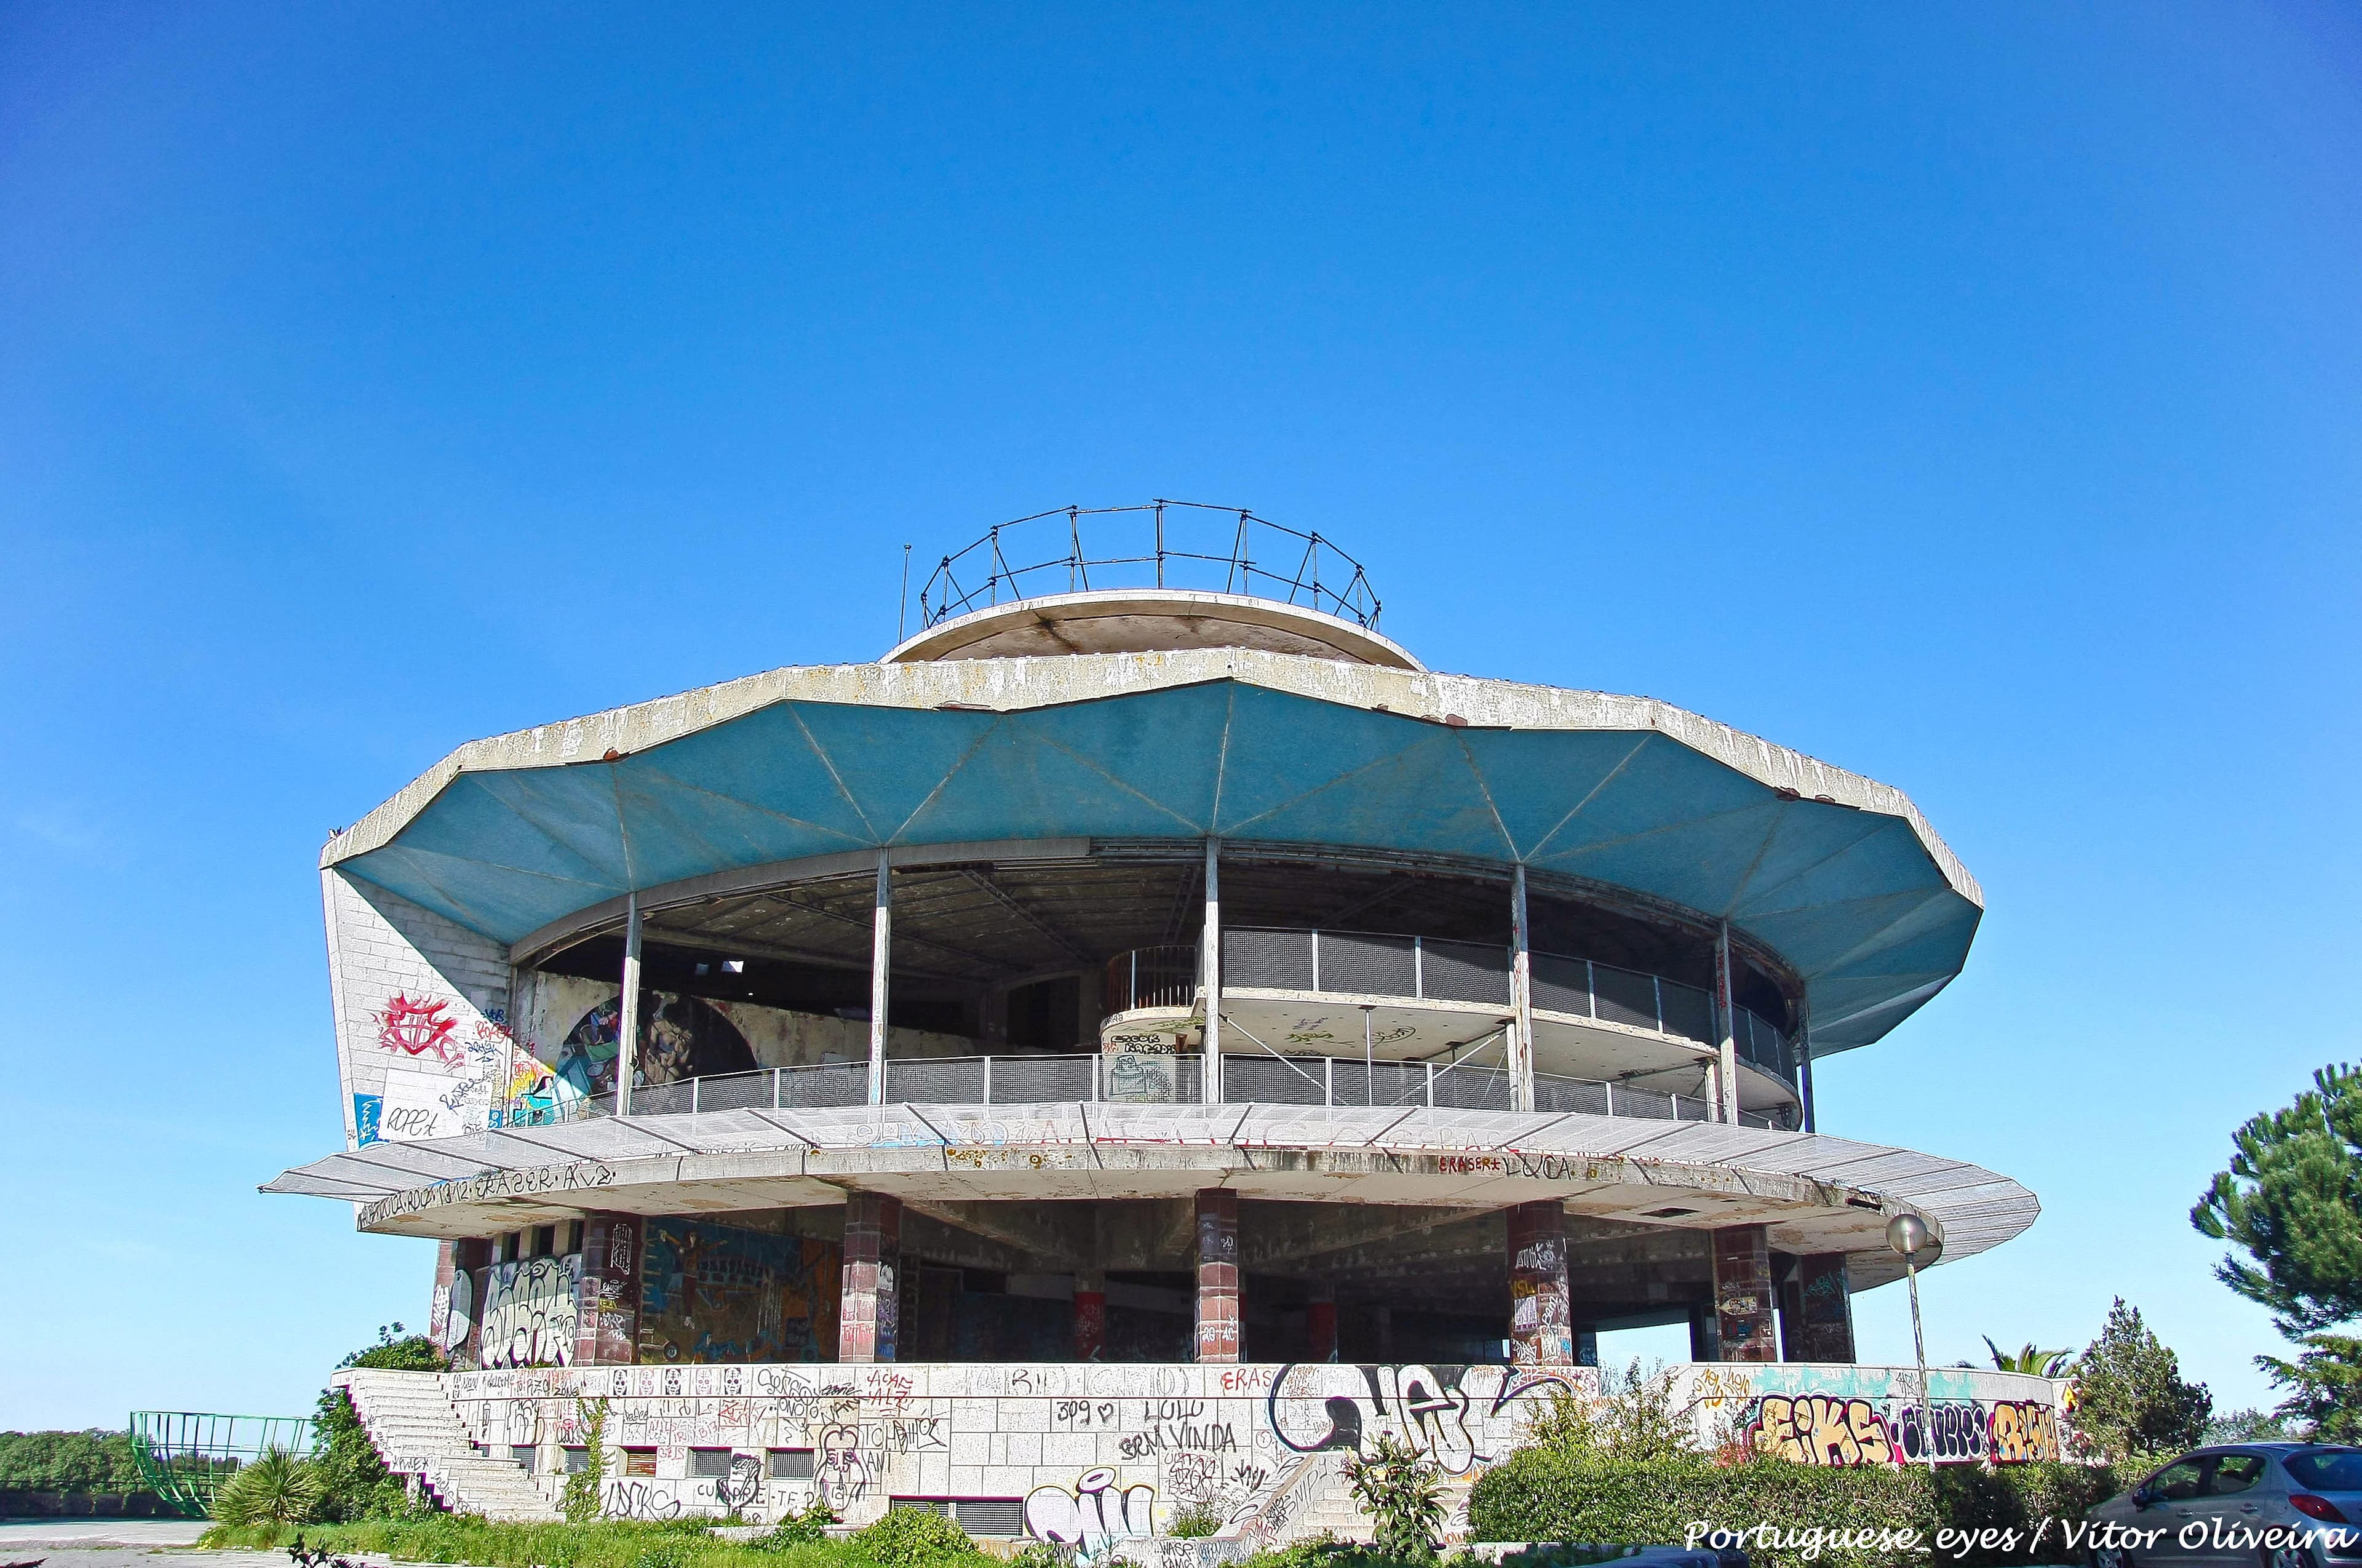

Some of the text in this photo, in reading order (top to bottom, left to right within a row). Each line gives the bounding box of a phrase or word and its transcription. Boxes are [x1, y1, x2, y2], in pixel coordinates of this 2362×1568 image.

[1057, 1400, 1091, 1425] 309
[1145, 1399, 1204, 1420] LULU
[1168, 1421, 1237, 1453] VINDA
